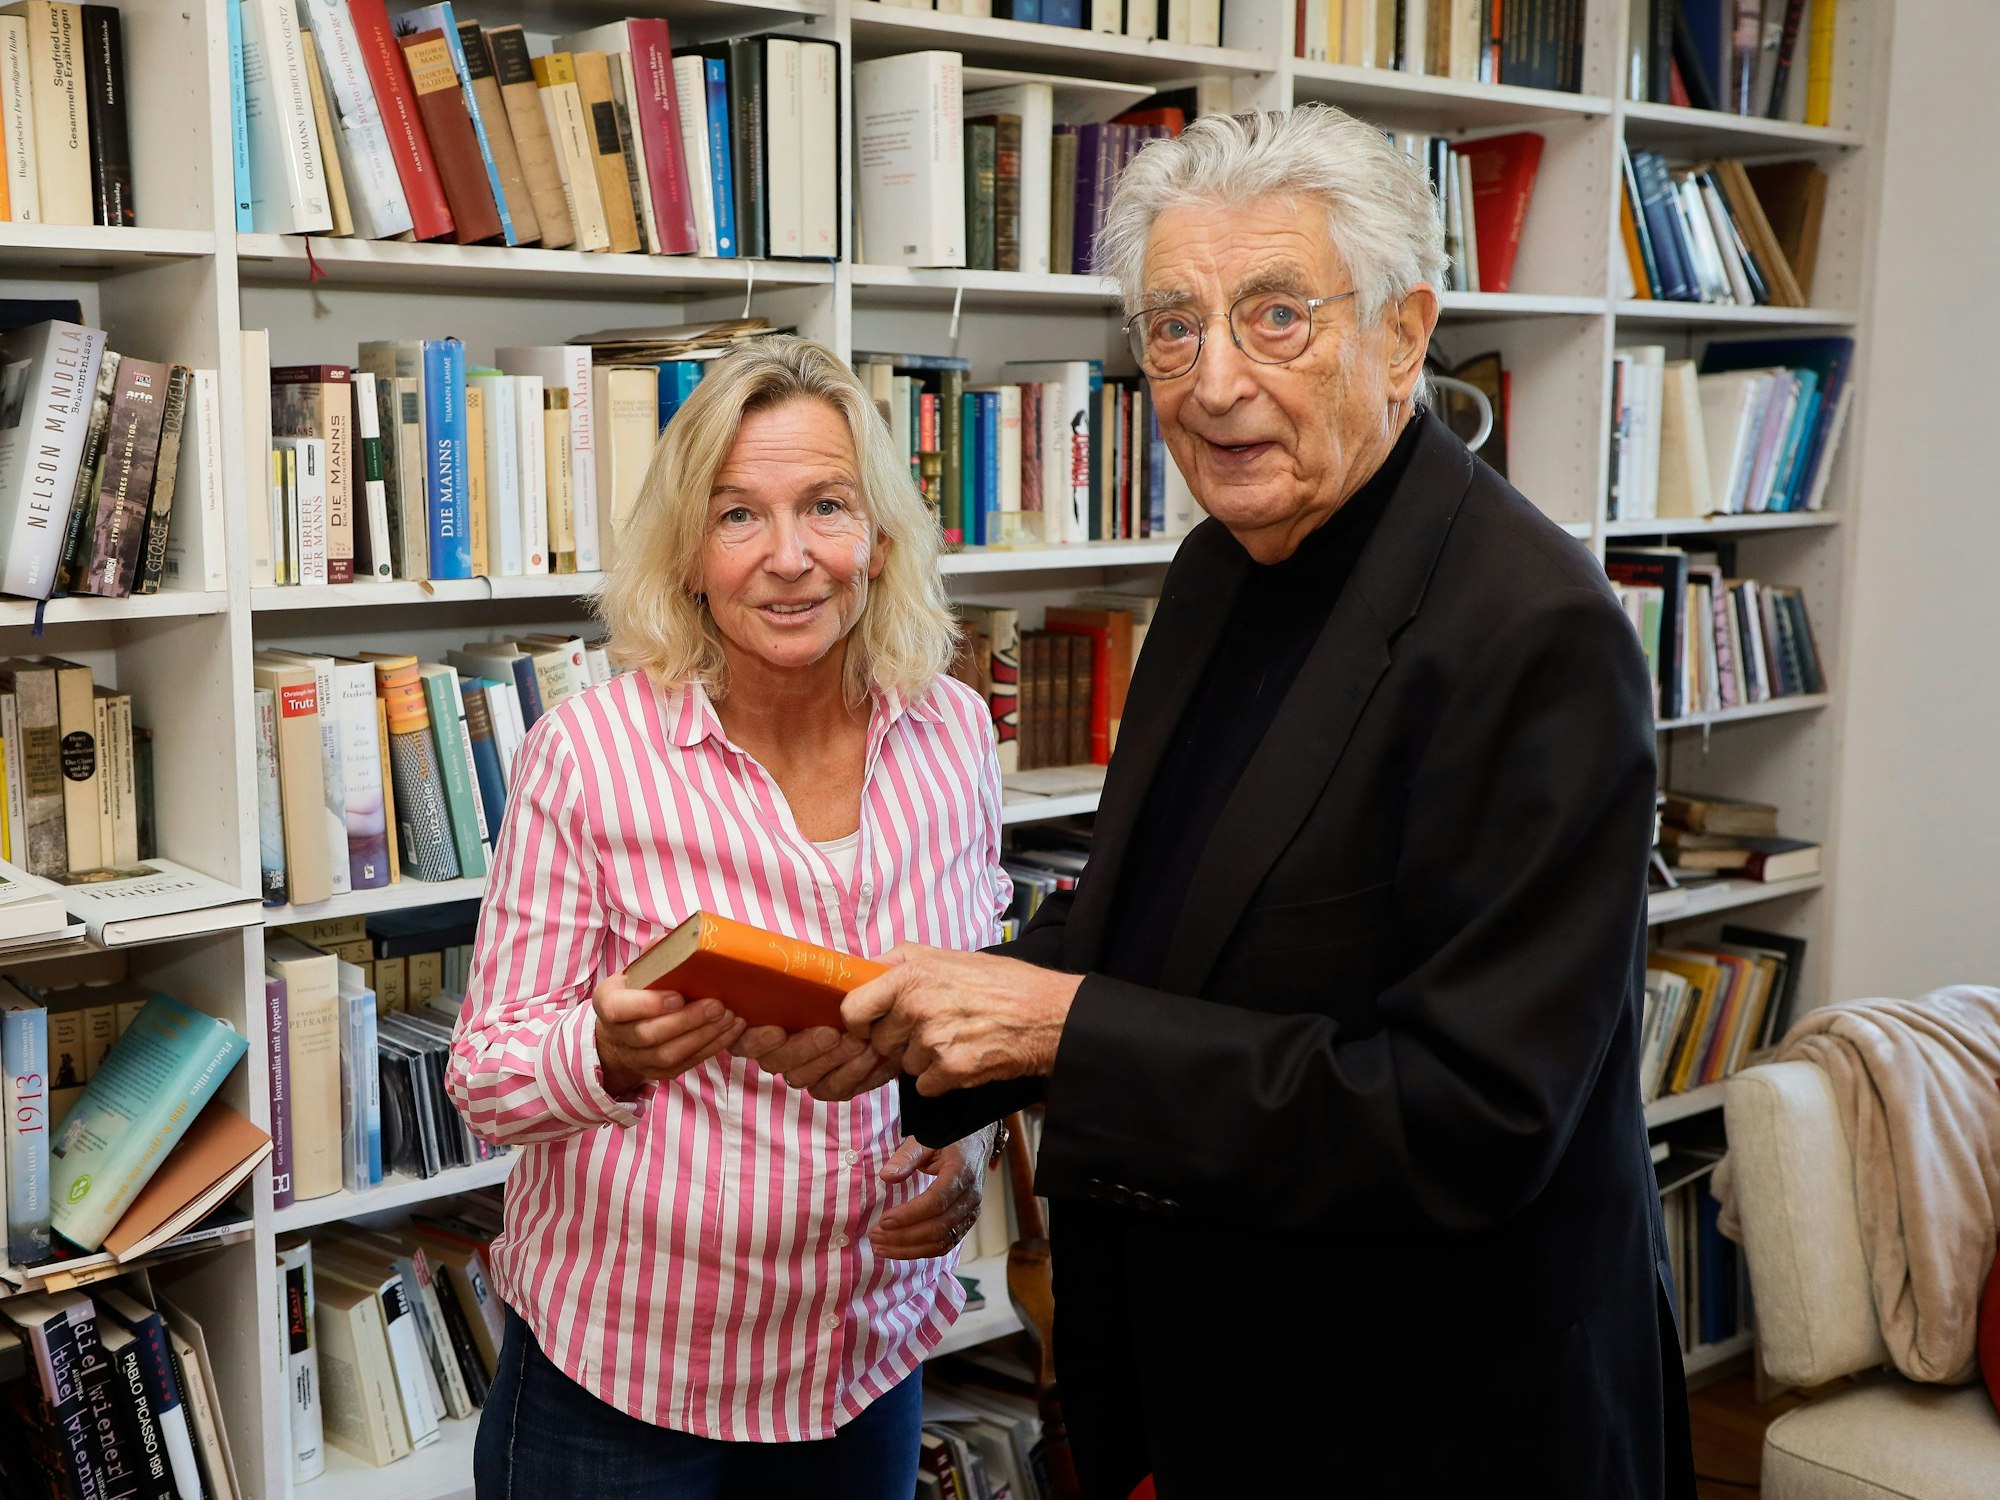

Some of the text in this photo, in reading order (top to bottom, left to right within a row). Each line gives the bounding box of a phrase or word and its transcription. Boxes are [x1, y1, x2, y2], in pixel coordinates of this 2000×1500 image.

[50, 7, 63, 86] Siegfried Lenz
[329, 11, 368, 124] Marta Feuchtwanger
[373, 25, 398, 92] Seelenzauber
[413, 45, 444, 57] THOMAS
[420, 53, 443, 63] MANN
[61, 9, 77, 148] Gesammelte Erzählungen
[279, 5, 313, 179] GOLO MANN FRIEDRICH VON GENTZ
[418, 67, 451, 80] DOKTOR
[395, 96, 422, 171] HANS RUDOLF VAGET
[18, 156, 27, 177] Hugo
[71, 335, 92, 413] Bekenntnisse
[443, 357, 451, 383] LAHME
[572, 357, 587, 408] Mann
[126, 390, 153, 400] arte
[28, 332, 79, 528] NELSON MANDELA
[124, 441, 133, 456] DEN
[572, 414, 590, 450] Julia
[122, 459, 130, 474] ALS
[330, 415, 341, 525] DIE MANNS
[438, 439, 453, 537] DIE MANNS
[115, 477, 127, 514] BESSERES
[64, 539, 74, 560] Hans
[145, 522, 167, 572] GEORGE
[301, 500, 312, 575] DIE BRIEFE
[313, 495, 323, 577] DER MANNS
[27, 556, 39, 584] PIPER
[288, 698, 313, 709] Trutz
[421, 783, 441, 843] Lutz Seiler
[313, 920, 360, 939] POE 4
[356, 945, 364, 957] 5
[418, 959, 431, 968] 2
[288, 1013, 337, 1029] PETRARCA
[190, 1041, 232, 1094] Florian Illies
[270, 997, 282, 1100] Journalist mit Appetit
[16, 1074, 42, 1133] 1913
[28, 1174, 36, 1210] FLORIAN
[394, 1284, 409, 1315] PIPER
[51, 1353, 71, 1396] the
[73, 1323, 95, 1367] die
[90, 1385, 126, 1474] wiener
[124, 1352, 163, 1479] PABLO PICASSO 1981
